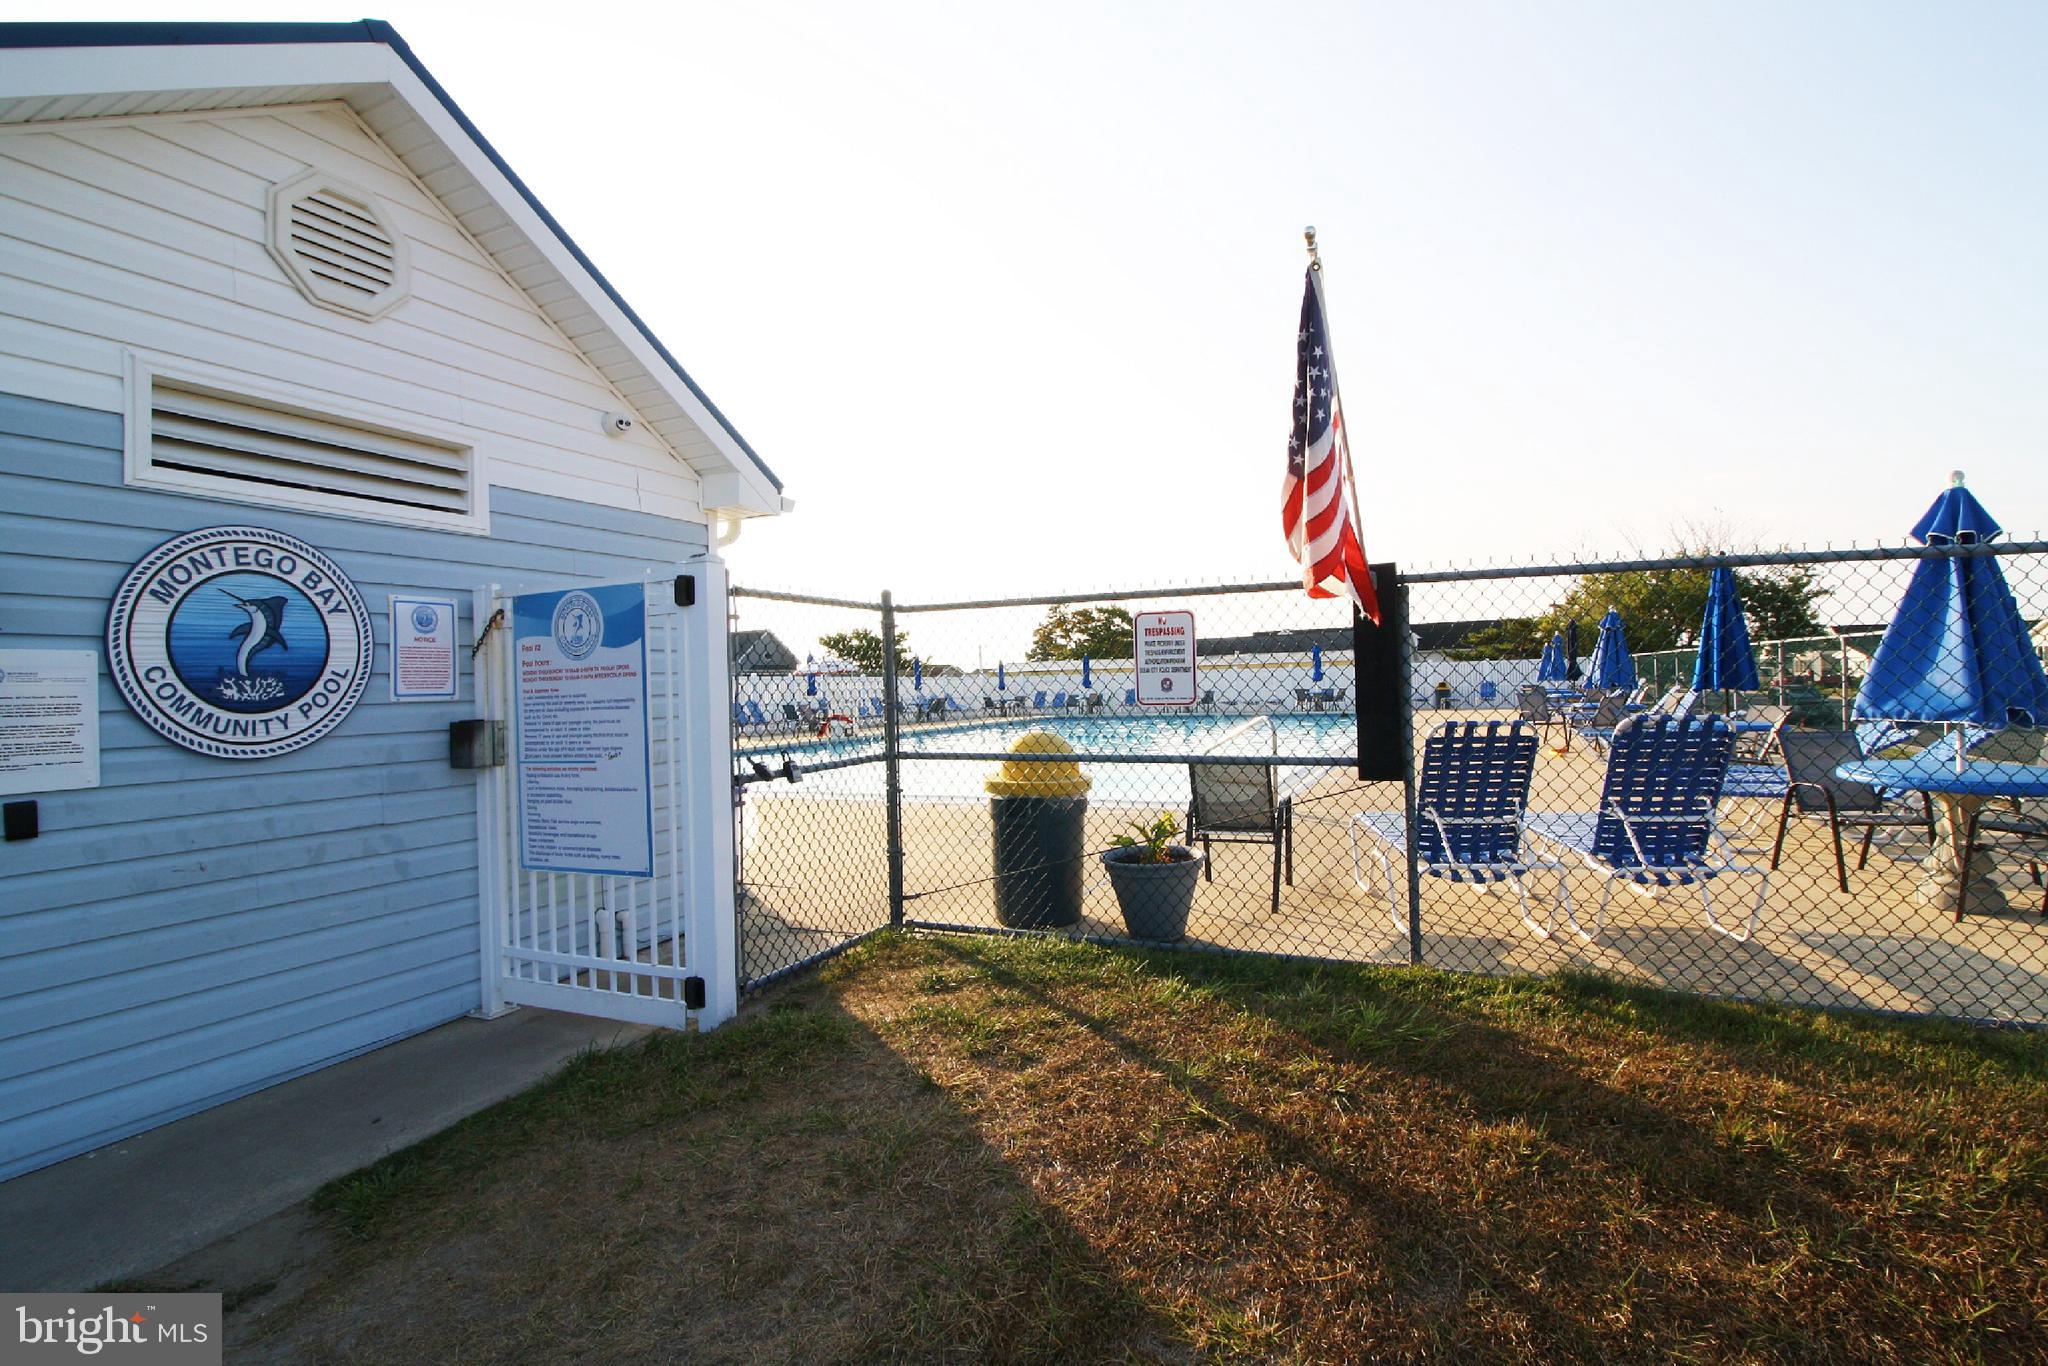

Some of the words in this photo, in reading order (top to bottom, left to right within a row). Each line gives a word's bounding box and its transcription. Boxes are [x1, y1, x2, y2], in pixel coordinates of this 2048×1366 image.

[149, 546, 297, 605] MONTEGO
[301, 569, 347, 616] BAY
[1144, 626, 1185, 637] TRESPASSING
[144, 665, 290, 737] COMMUNITY
[298, 667, 350, 719] POOL
